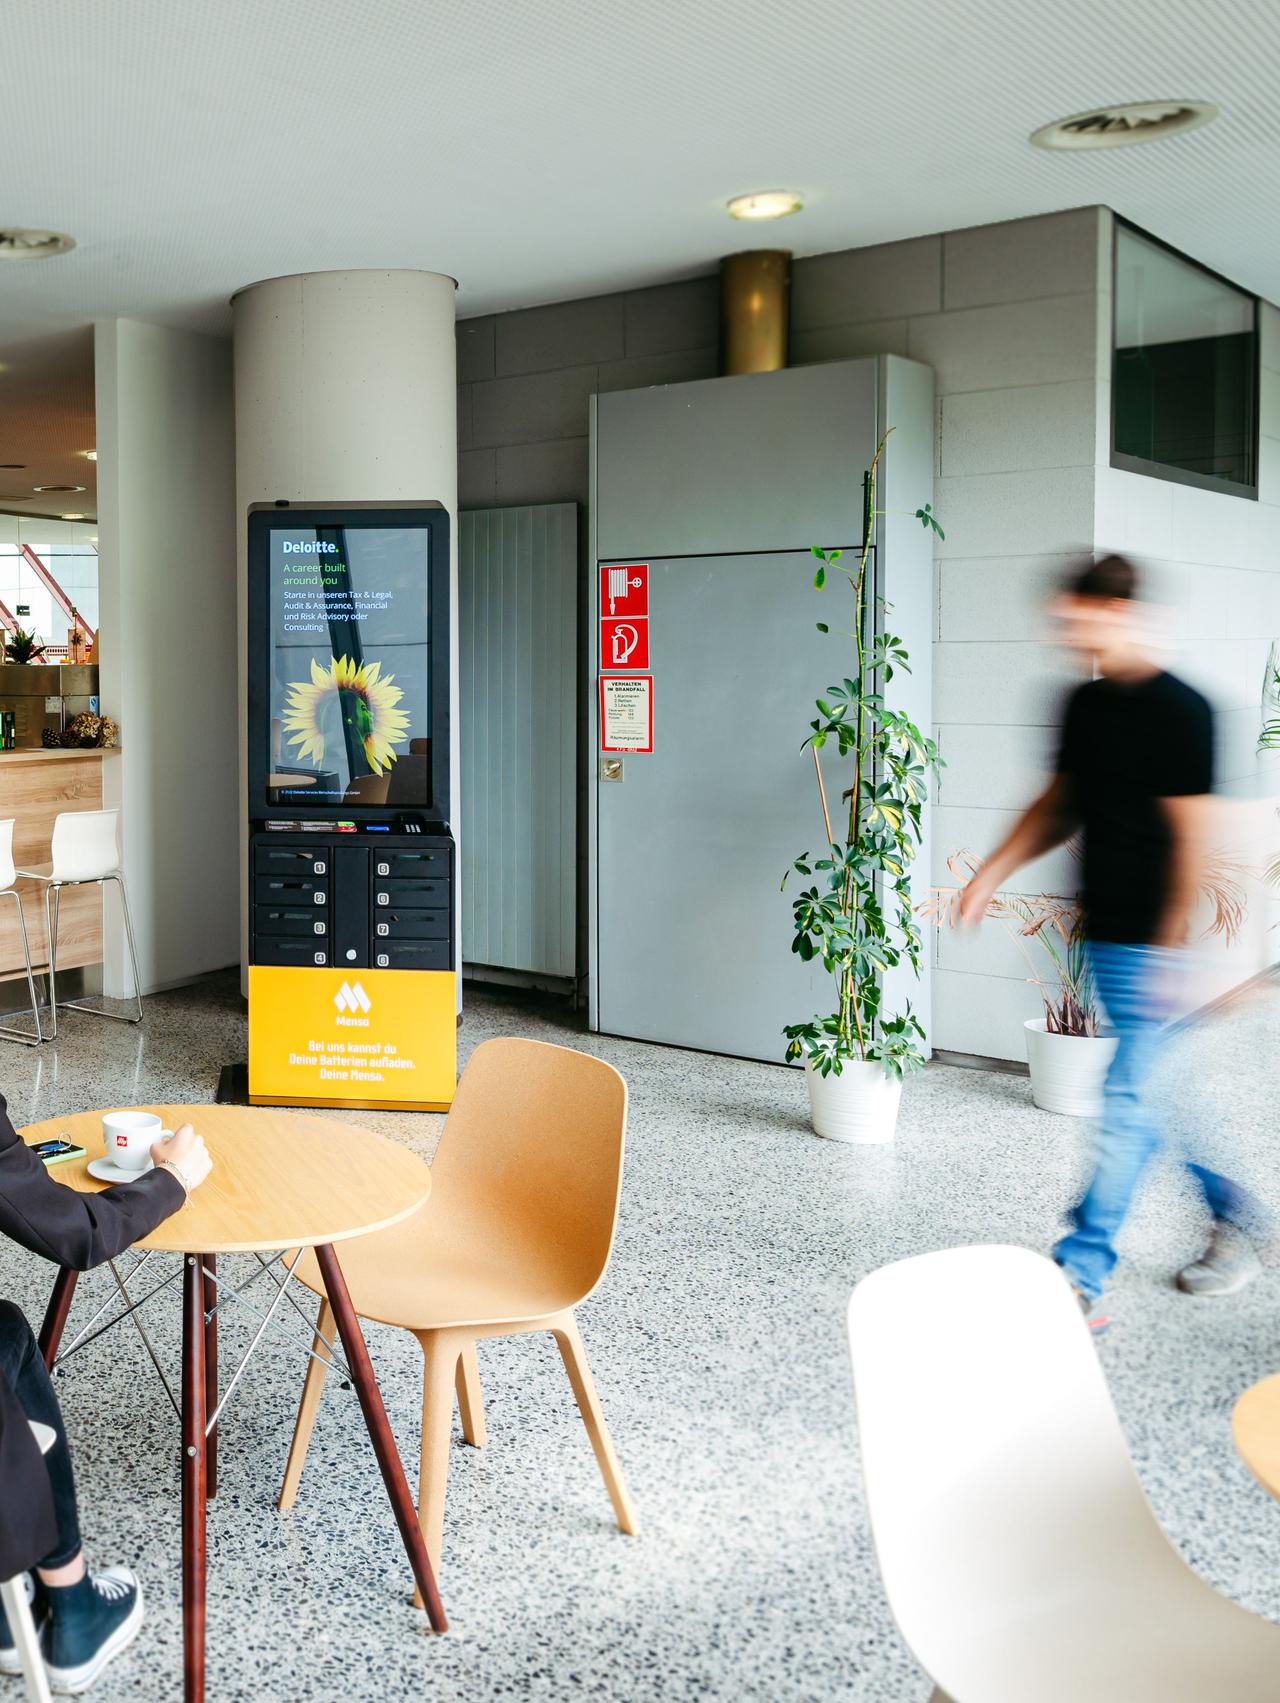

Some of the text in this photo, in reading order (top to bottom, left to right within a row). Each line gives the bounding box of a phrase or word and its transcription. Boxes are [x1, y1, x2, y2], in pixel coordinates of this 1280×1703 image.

[283, 541, 339, 553] Deloitte.
[283, 564, 290, 572] A
[324, 564, 346, 572] built
[283, 576, 338, 586] around you
[371, 591, 393, 600] Legal,
[316, 613, 349, 622] Advisory
[284, 623, 324, 632] Consulting
[335, 1016, 370, 1027] Mensa
[308, 1040, 397, 1055] Bei uns kannst du
[289, 1053, 416, 1069] Deine Batterien aufladen.
[320, 1068, 384, 1082] Deine Mensa.
